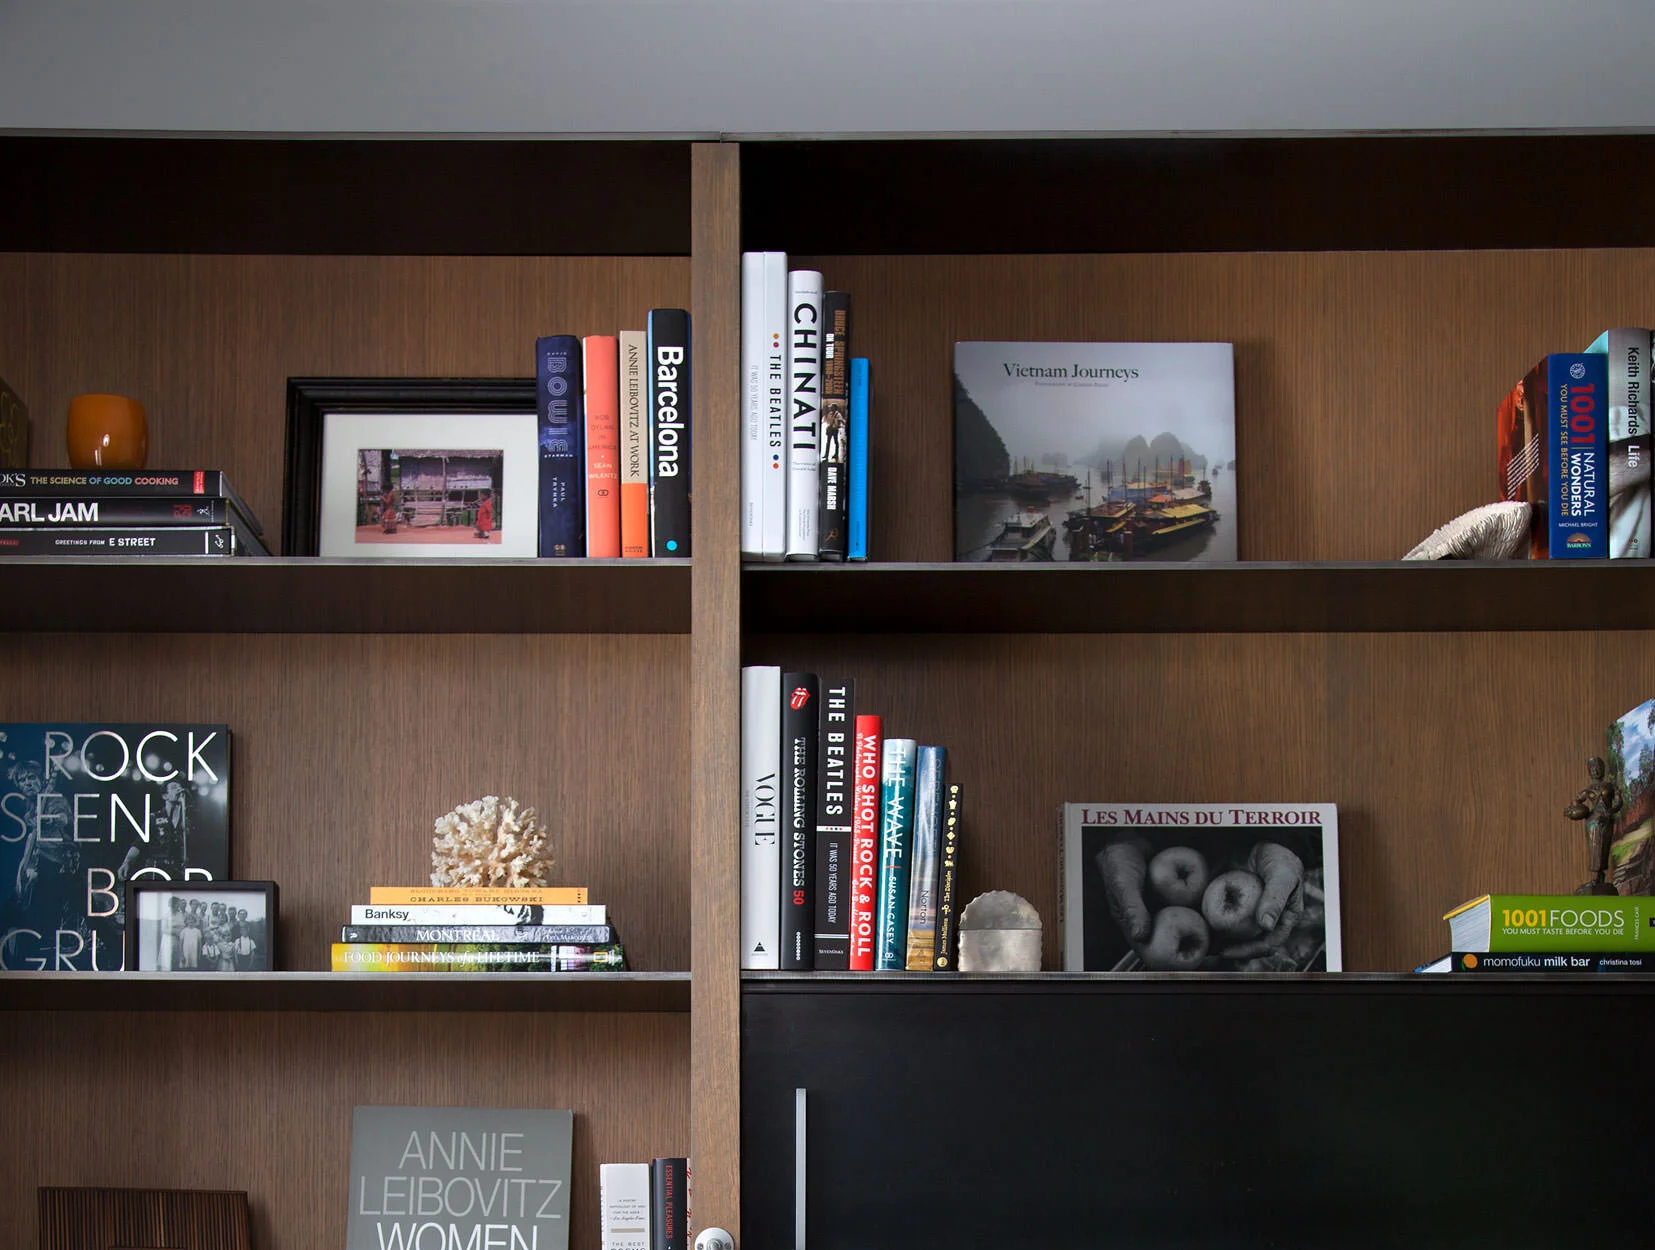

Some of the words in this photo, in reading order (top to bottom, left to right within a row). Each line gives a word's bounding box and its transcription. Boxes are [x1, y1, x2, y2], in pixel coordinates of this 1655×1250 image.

[825, 333, 835, 342] ON
[825, 343, 835, 359] TOUR
[628, 344, 638, 376] ANNIE
[769, 355, 782, 380] THE
[793, 302, 817, 450] CHINATI
[1003, 362, 1068, 378] Vietnam
[1071, 363, 1140, 383] Journeys
[1627, 346, 1640, 378] Keith
[547, 357, 569, 452] BOWIE
[629, 377, 639, 428] LEIBOVITZ
[1560, 384, 1568, 402] YOU
[1627, 381, 1640, 435] Richards
[657, 346, 685, 478] Barcelona
[769, 388, 782, 447] BEATLES
[1560, 405, 1568, 429] MUST
[1570, 383, 1595, 444] 1001
[629, 430, 639, 444] AT
[1560, 431, 1568, 445] SEE
[630, 444, 640, 477] WORK
[1560, 447, 1569, 479] BEFORE
[1627, 445, 1640, 468] Life
[30, 476, 48, 485] THE
[50, 476, 87, 485] SCIENCE
[89, 477, 101, 485] OF
[103, 477, 133, 485] GOOD
[135, 477, 179, 485] COOKING
[826, 466, 837, 483] DAVE
[1571, 453, 1582, 517] WONDERS
[1583, 452, 1595, 517] NATURAL
[826, 485, 837, 510] MARSH
[1560, 481, 1569, 501] YOU
[0, 502, 45, 523] ARL
[48, 502, 99, 522] JAM
[1561, 503, 1569, 517] DIE
[55, 538, 88, 546] GREETINGS
[109, 537, 116, 547] E
[118, 537, 156, 547] STREET
[828, 686, 847, 722] THE
[44, 730, 219, 782] ROCK
[793, 736, 806, 765] THE
[862, 735, 877, 779] WHO
[826, 732, 846, 816] BEATLES
[888, 747, 906, 788] THE
[754, 772, 776, 846] VOGUE
[793, 768, 806, 829] ROLLING
[861, 784, 876, 833] SHOT
[0, 792, 151, 843] SEEN
[885, 796, 905, 859] WAVE
[1081, 809, 1117, 825] LES
[1124, 809, 1190, 825] MAINS
[1194, 811, 1223, 825] DU
[1229, 809, 1322, 825] TERROIR
[792, 832, 806, 887] STONES
[828, 850, 838, 863] WAS
[828, 863, 838, 872] 50
[859, 838, 875, 888] ROCK
[792, 889, 805, 906] 50
[827, 872, 838, 891] YEARS
[887, 876, 897, 911] SUSAN
[827, 892, 837, 904] AGO
[859, 894, 871, 904] &
[919, 889, 931, 925] Norton
[364, 908, 410, 922] Banksy
[826, 905, 837, 924] TODAY
[886, 912, 895, 944] CASEY
[1502, 909, 1547, 927] 1001
[1550, 909, 1625, 928] FOODS
[857, 911, 872, 957] ROLL
[1594, 928, 1611, 936] YOU
[1613, 928, 1625, 936] DIE
[0, 928, 126, 972] GRU
[343, 951, 383, 963] FOOD
[384, 951, 455, 967] JOURNEYS
[456, 950, 470, 968] of
[478, 951, 541, 963] LIFETIME
[1483, 956, 1541, 967] momofuku
[1544, 956, 1568, 967] milk
[1570, 956, 1591, 967] bar
[1599, 958, 1628, 966] christina
[1629, 958, 1643, 966] tosi
[398, 1130, 525, 1172] ANNIE
[359, 1175, 563, 1219] LEIBOVITZ
[665, 1164, 673, 1200] ESSENTIAL
[665, 1201, 673, 1240] PLEASURES
